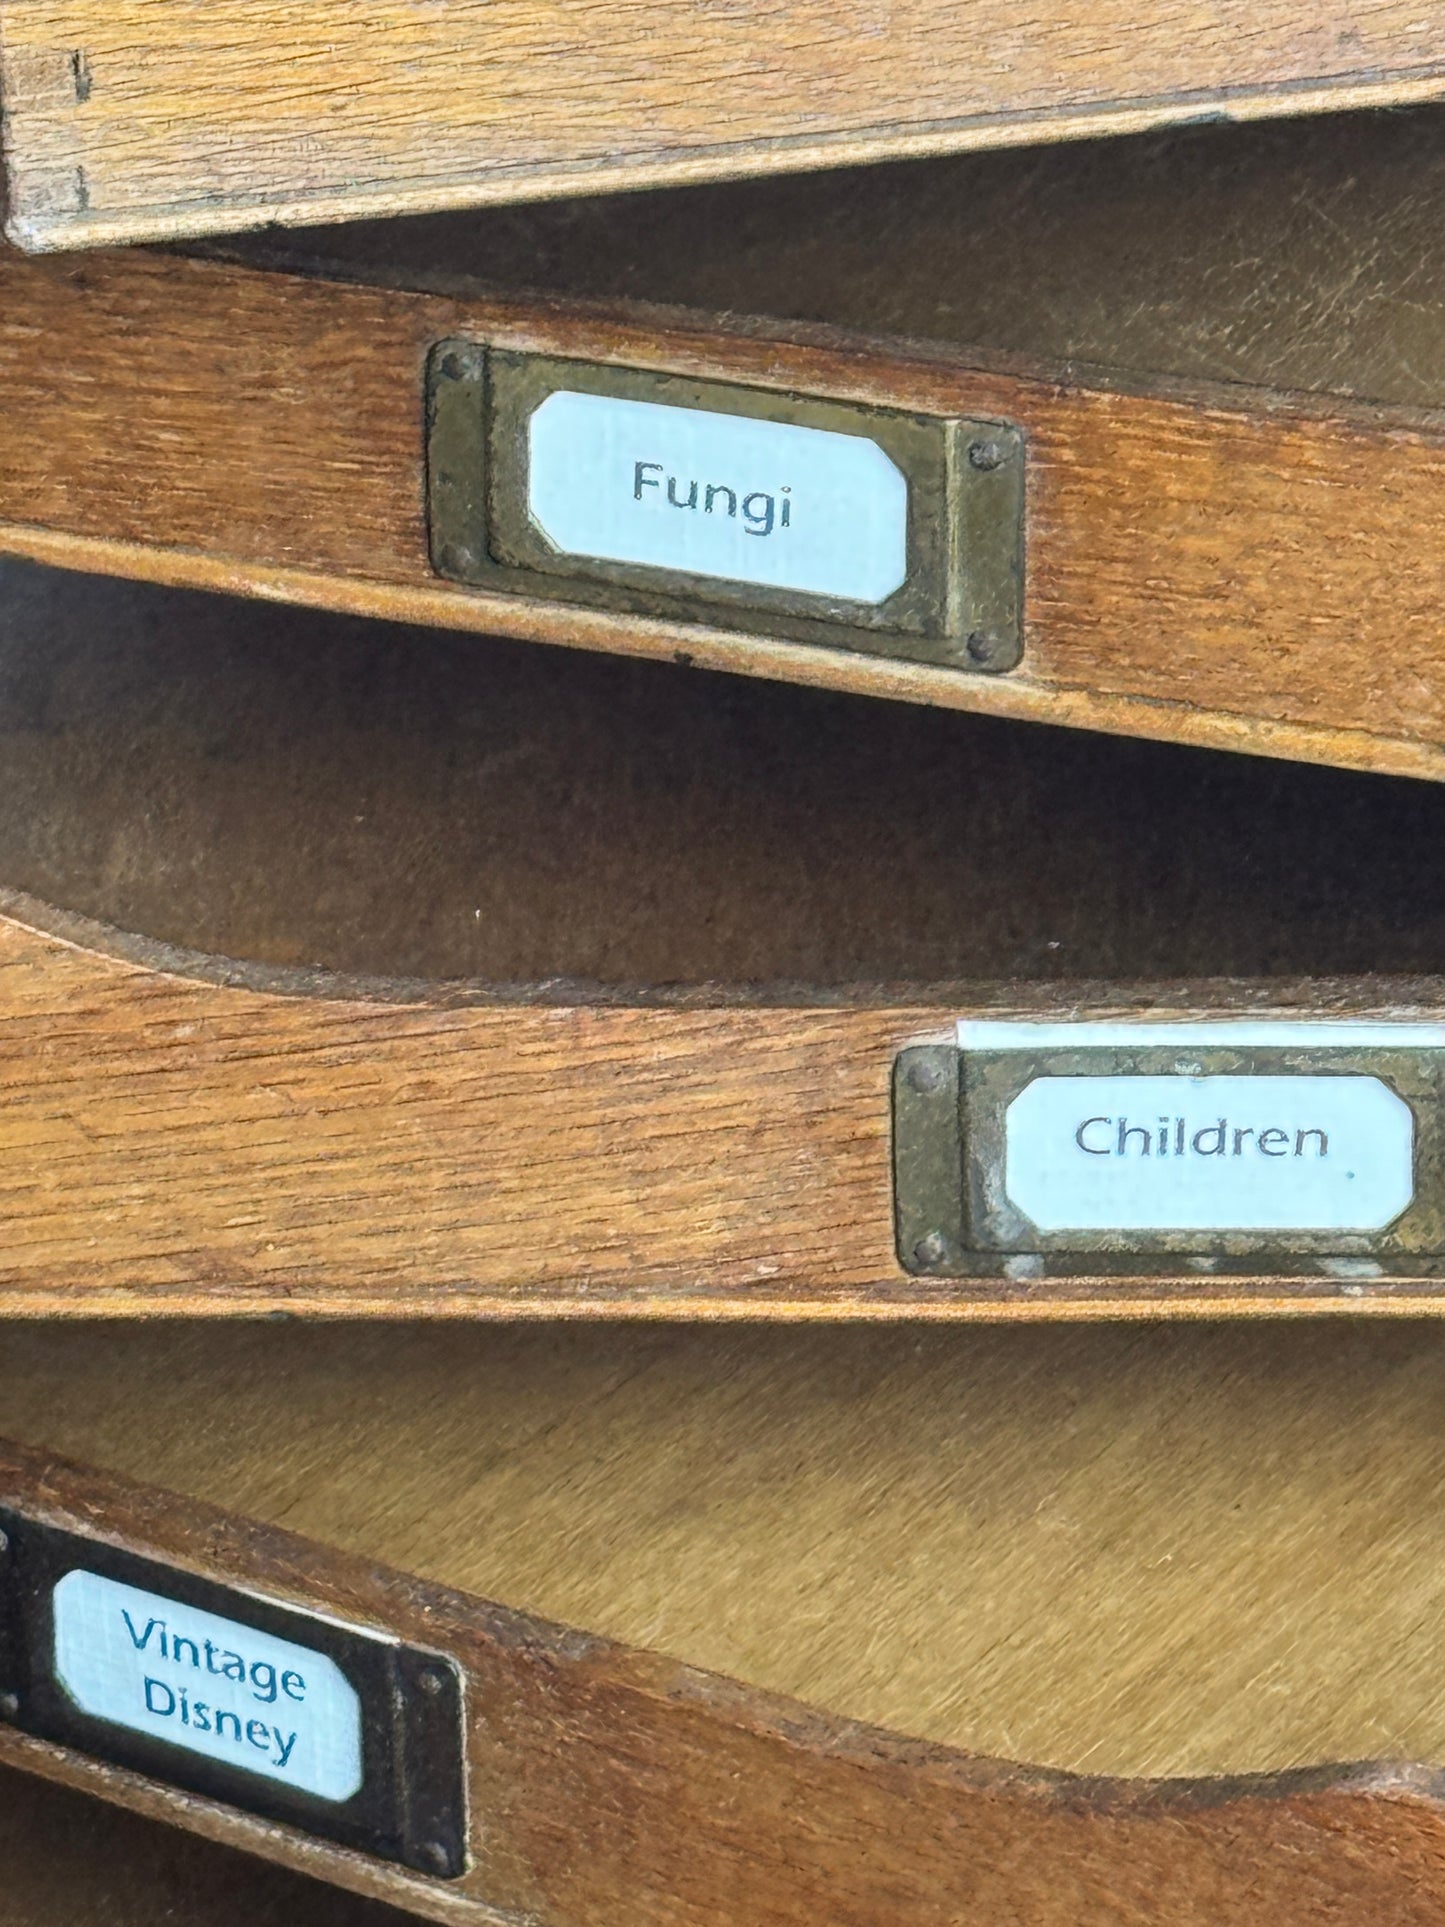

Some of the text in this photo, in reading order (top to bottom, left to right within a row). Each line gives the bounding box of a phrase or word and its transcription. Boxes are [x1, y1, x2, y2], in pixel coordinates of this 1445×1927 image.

[633, 461, 792, 538] Fungi
[1075, 1116, 1329, 1157] Children
[121, 1608, 306, 1704] Vintage
[144, 1675, 298, 1768] Disney
